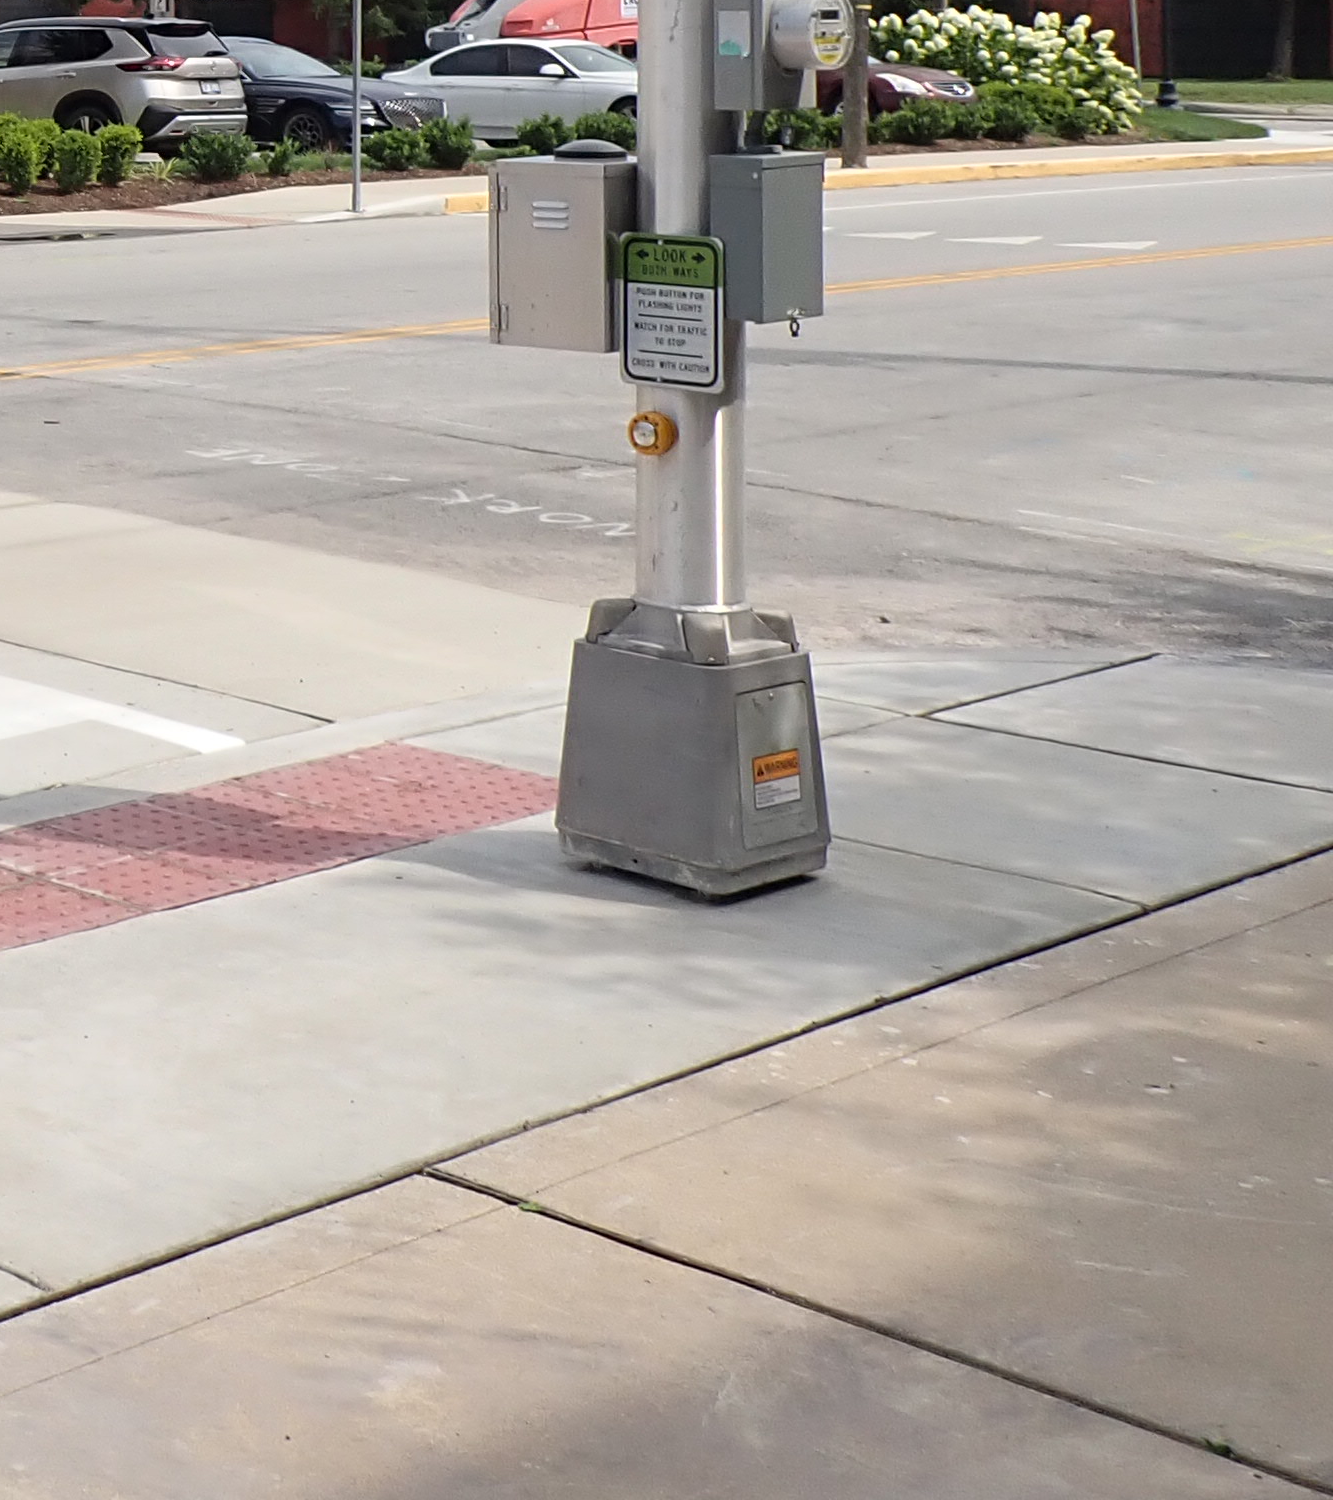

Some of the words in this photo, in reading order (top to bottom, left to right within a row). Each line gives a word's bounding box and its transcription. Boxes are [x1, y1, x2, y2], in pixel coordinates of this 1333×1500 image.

[653, 248, 687, 263] LOOK
[642, 264, 668, 276] BOTH
[673, 267, 699, 278] WAYS
[659, 288, 688, 298] BUTTON
[689, 291, 705, 300] FOR
[638, 299, 674, 310] FLASHING
[676, 303, 702, 313] LIGHTS
[634, 322, 658, 332] WATCH
[659, 324, 674, 333] FOR
[677, 326, 707, 336] TRAFFIC
[654, 337, 664, 346] TO
[667, 338, 687, 347] STOP
[631, 358, 655, 368] CROSS
[659, 360, 677, 370] WITH
[678, 362, 710, 373] CAUTION
